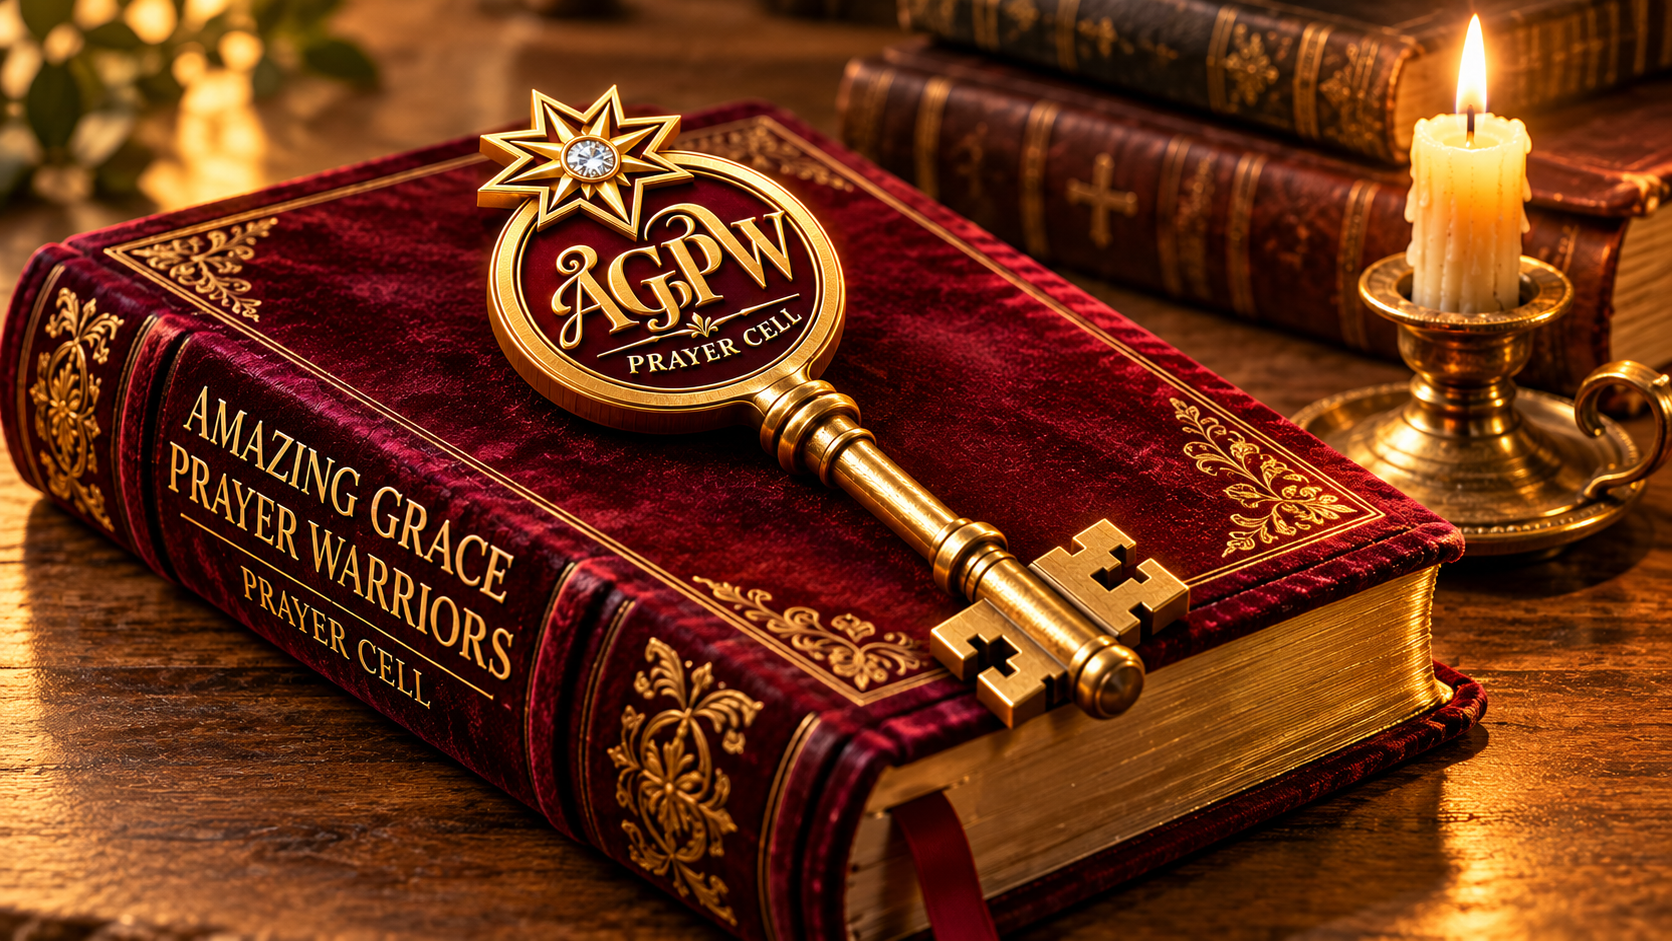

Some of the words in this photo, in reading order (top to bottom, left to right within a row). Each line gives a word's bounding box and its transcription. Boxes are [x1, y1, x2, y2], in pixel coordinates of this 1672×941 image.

[551, 203, 793, 349] AGPW
[627, 337, 741, 374] PRAYER
[743, 308, 802, 346] CELL
[168, 441, 299, 561] PRAYER
[308, 520, 514, 680] WARRIORS
[183, 385, 360, 517] AMAZING
[371, 486, 514, 603] GRACE
[240, 565, 350, 660] PRAYER
[357, 638, 431, 709] CELL
